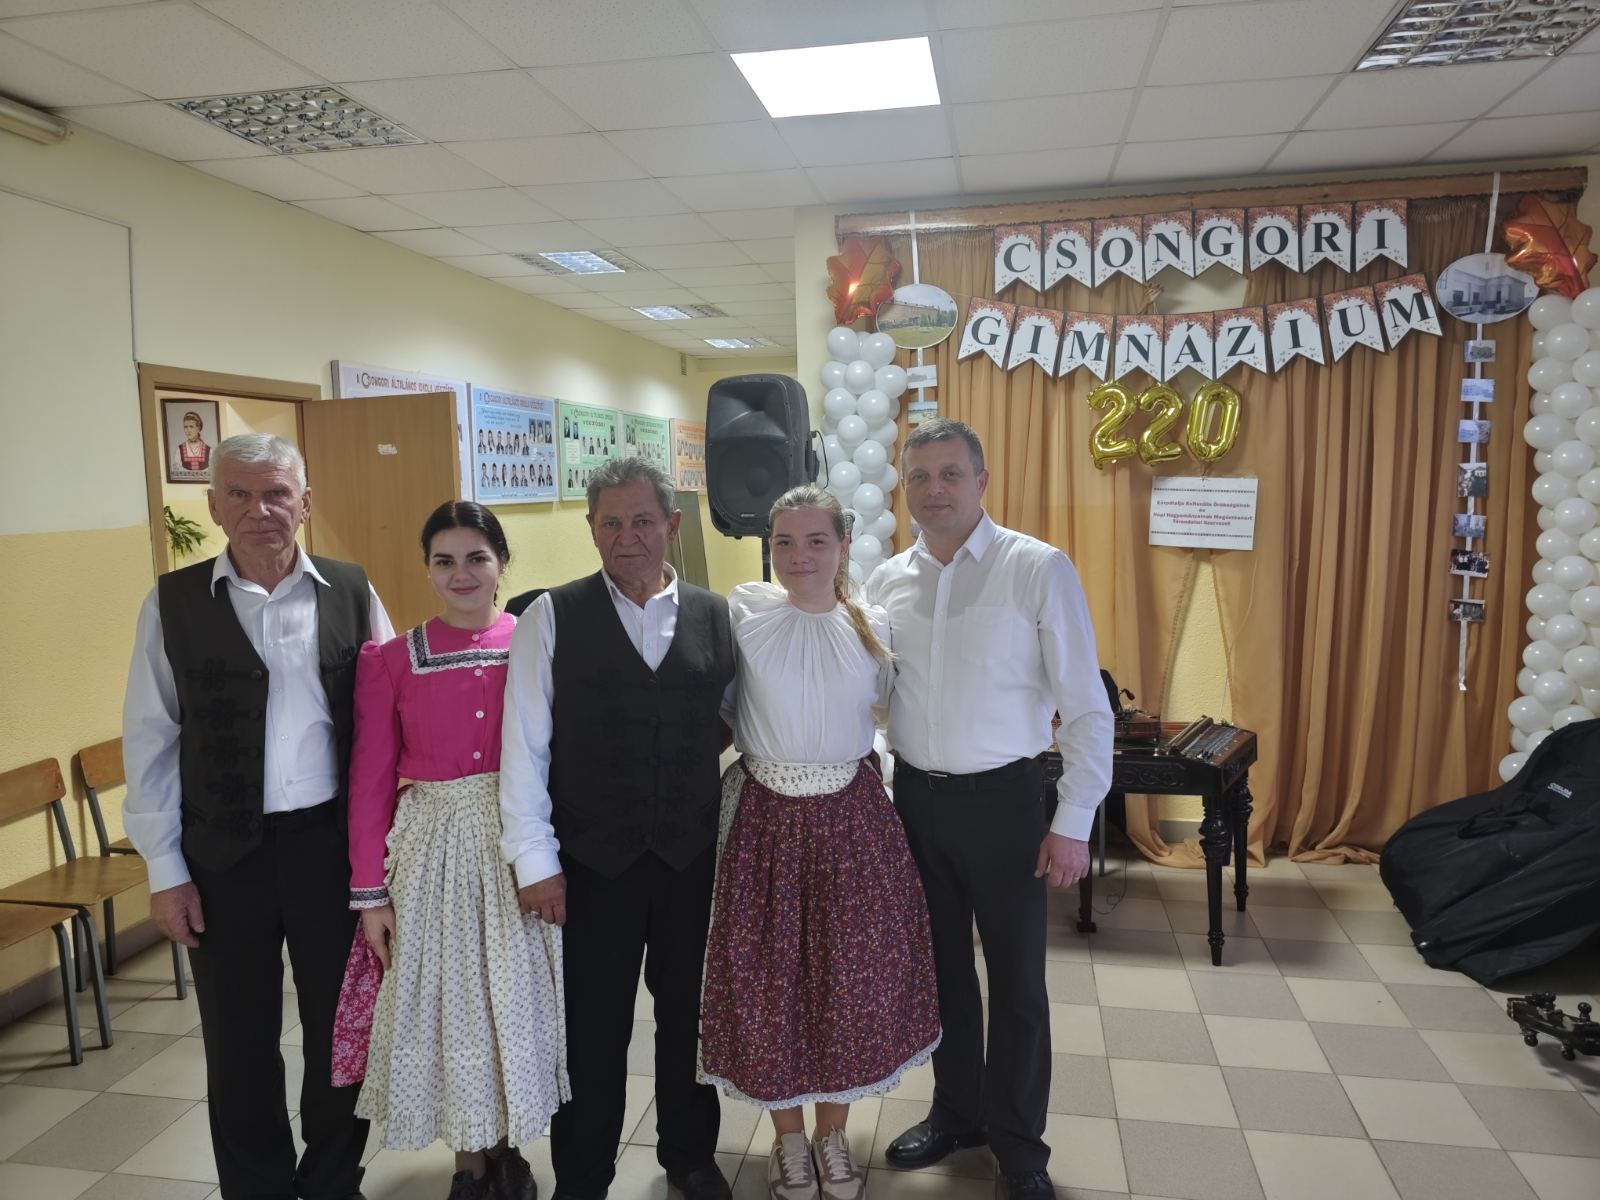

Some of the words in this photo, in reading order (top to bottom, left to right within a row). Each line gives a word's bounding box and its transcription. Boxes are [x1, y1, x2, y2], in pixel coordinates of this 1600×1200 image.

[1002, 218, 1392, 273] CSONGORI
[971, 291, 1432, 364] GIMNÁZIUM
[1087, 380, 1242, 470] 220
